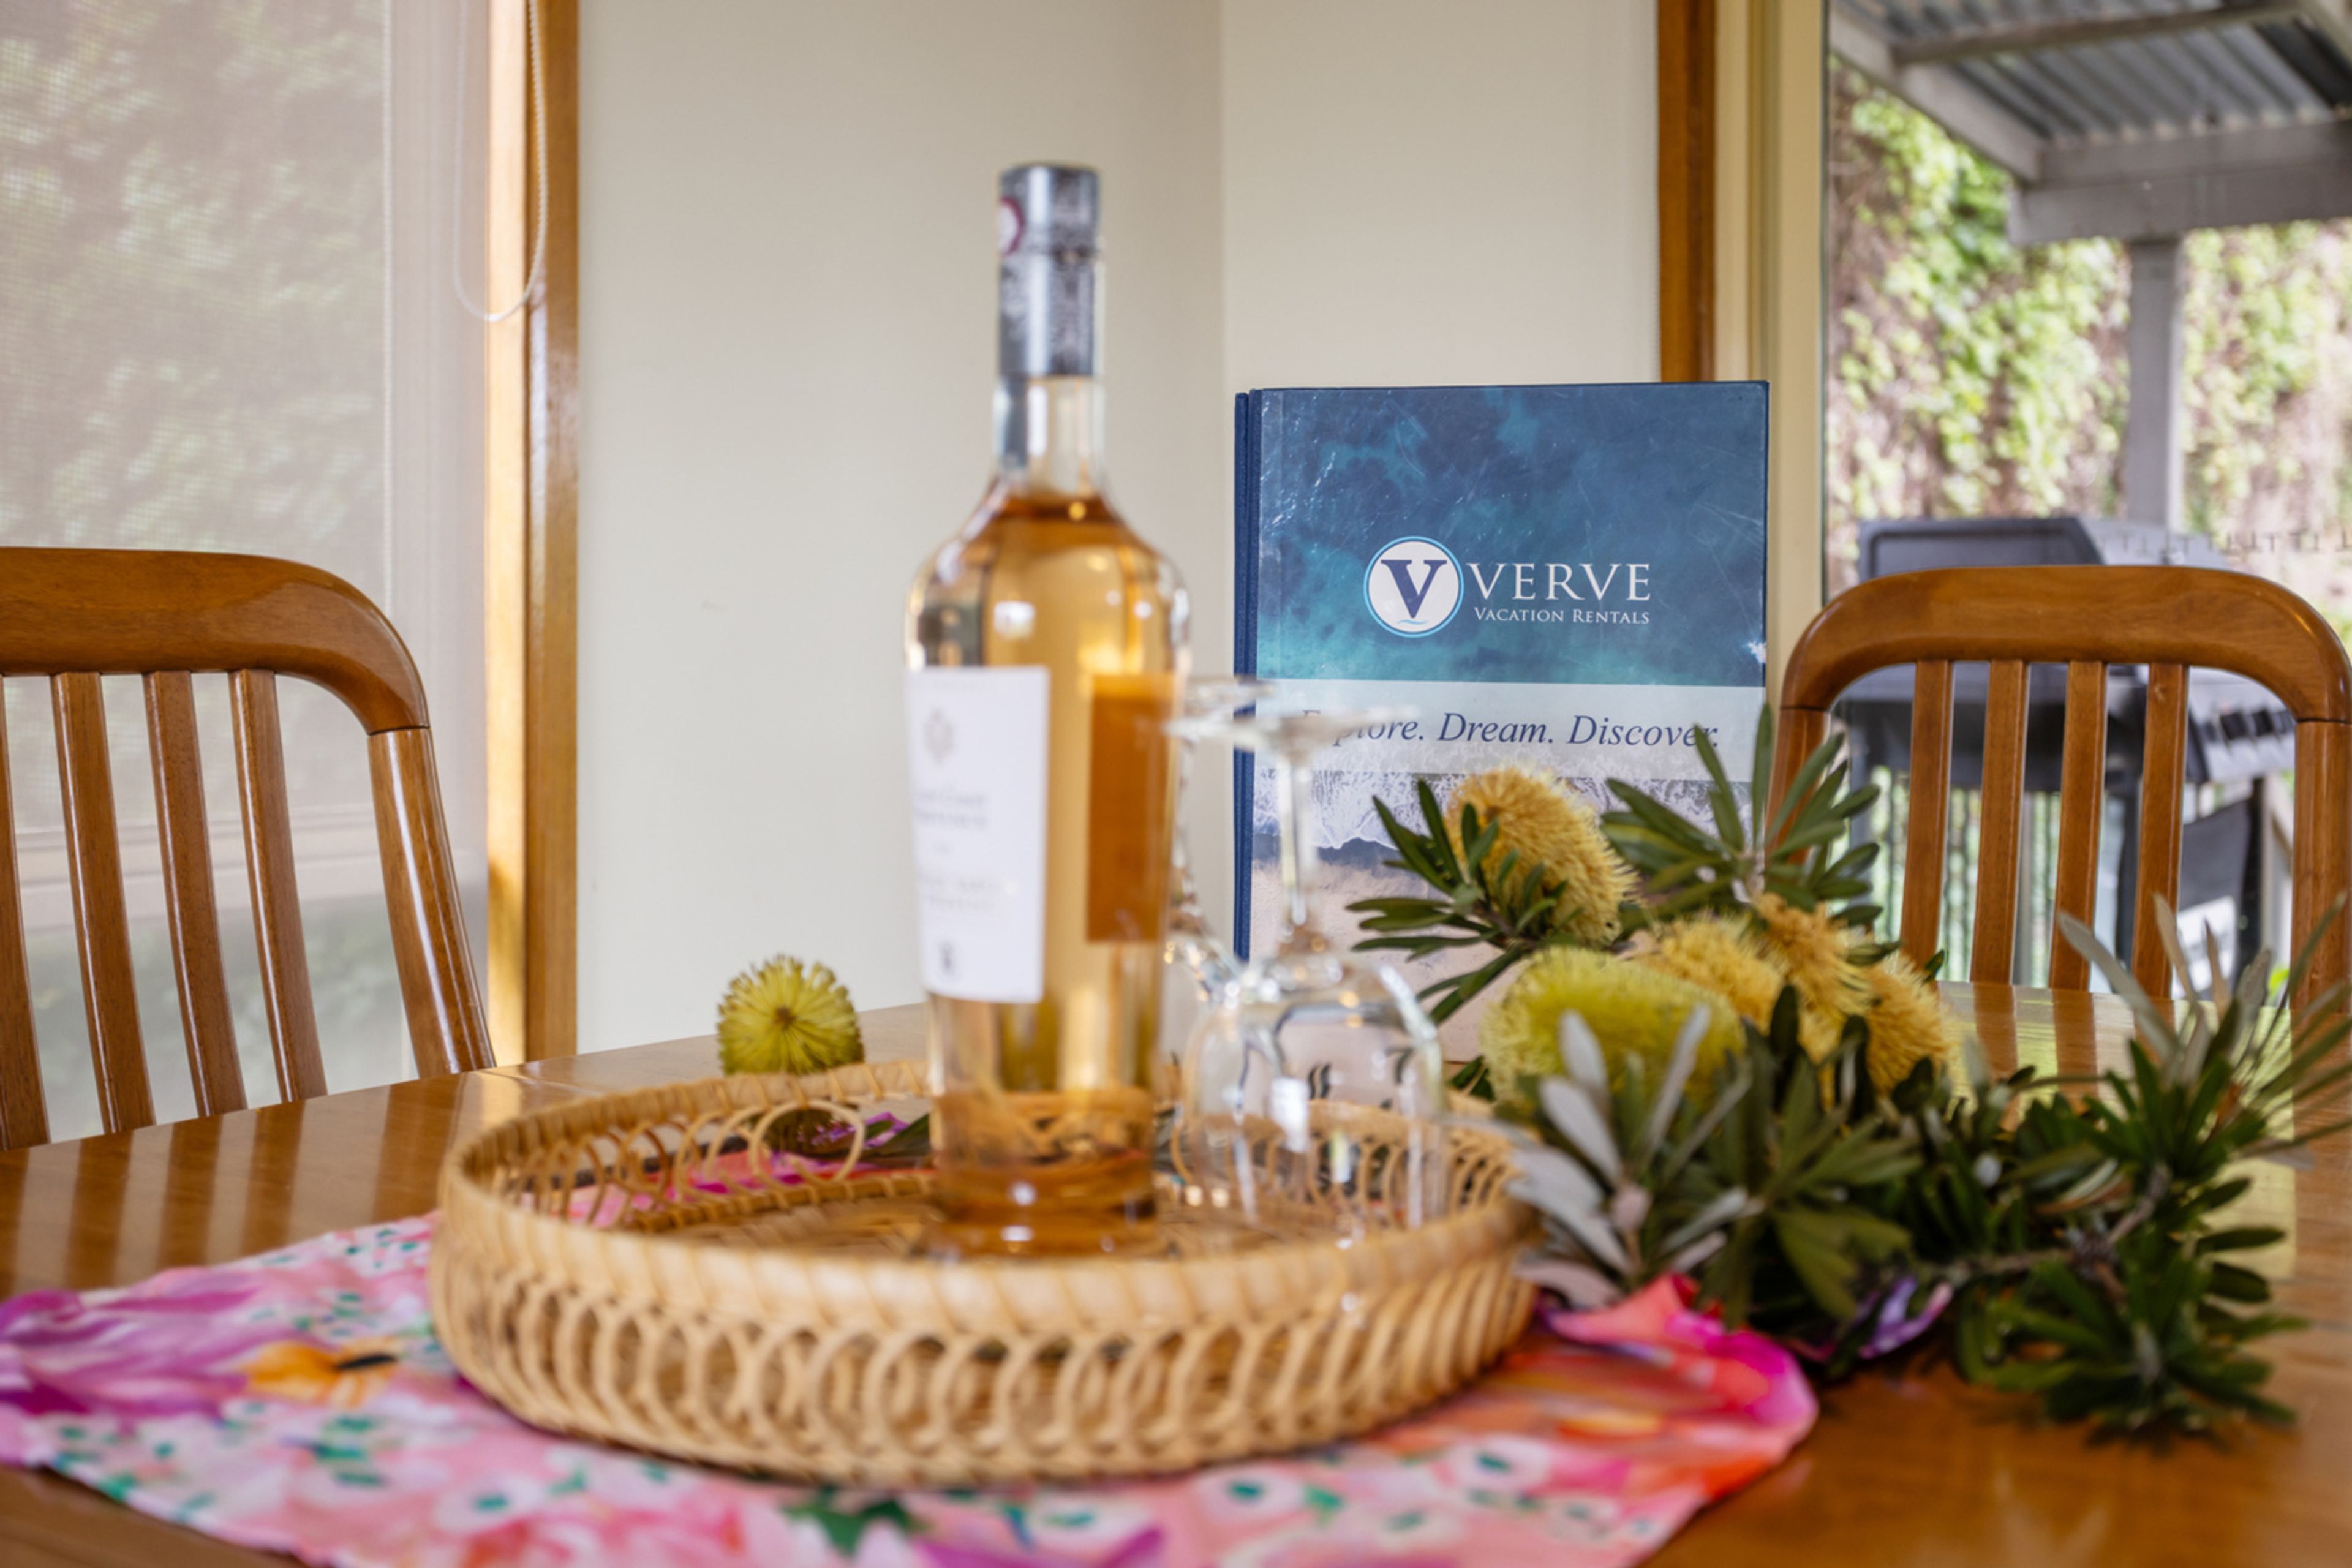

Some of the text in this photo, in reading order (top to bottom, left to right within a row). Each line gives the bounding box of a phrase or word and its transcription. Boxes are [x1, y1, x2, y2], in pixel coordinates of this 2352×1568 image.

[1380, 559, 1448, 619] V
[1465, 562, 1651, 601] VERVE
[1473, 606, 1649, 625] VACATION RENTALS
[1436, 712, 1553, 744] Dream.
